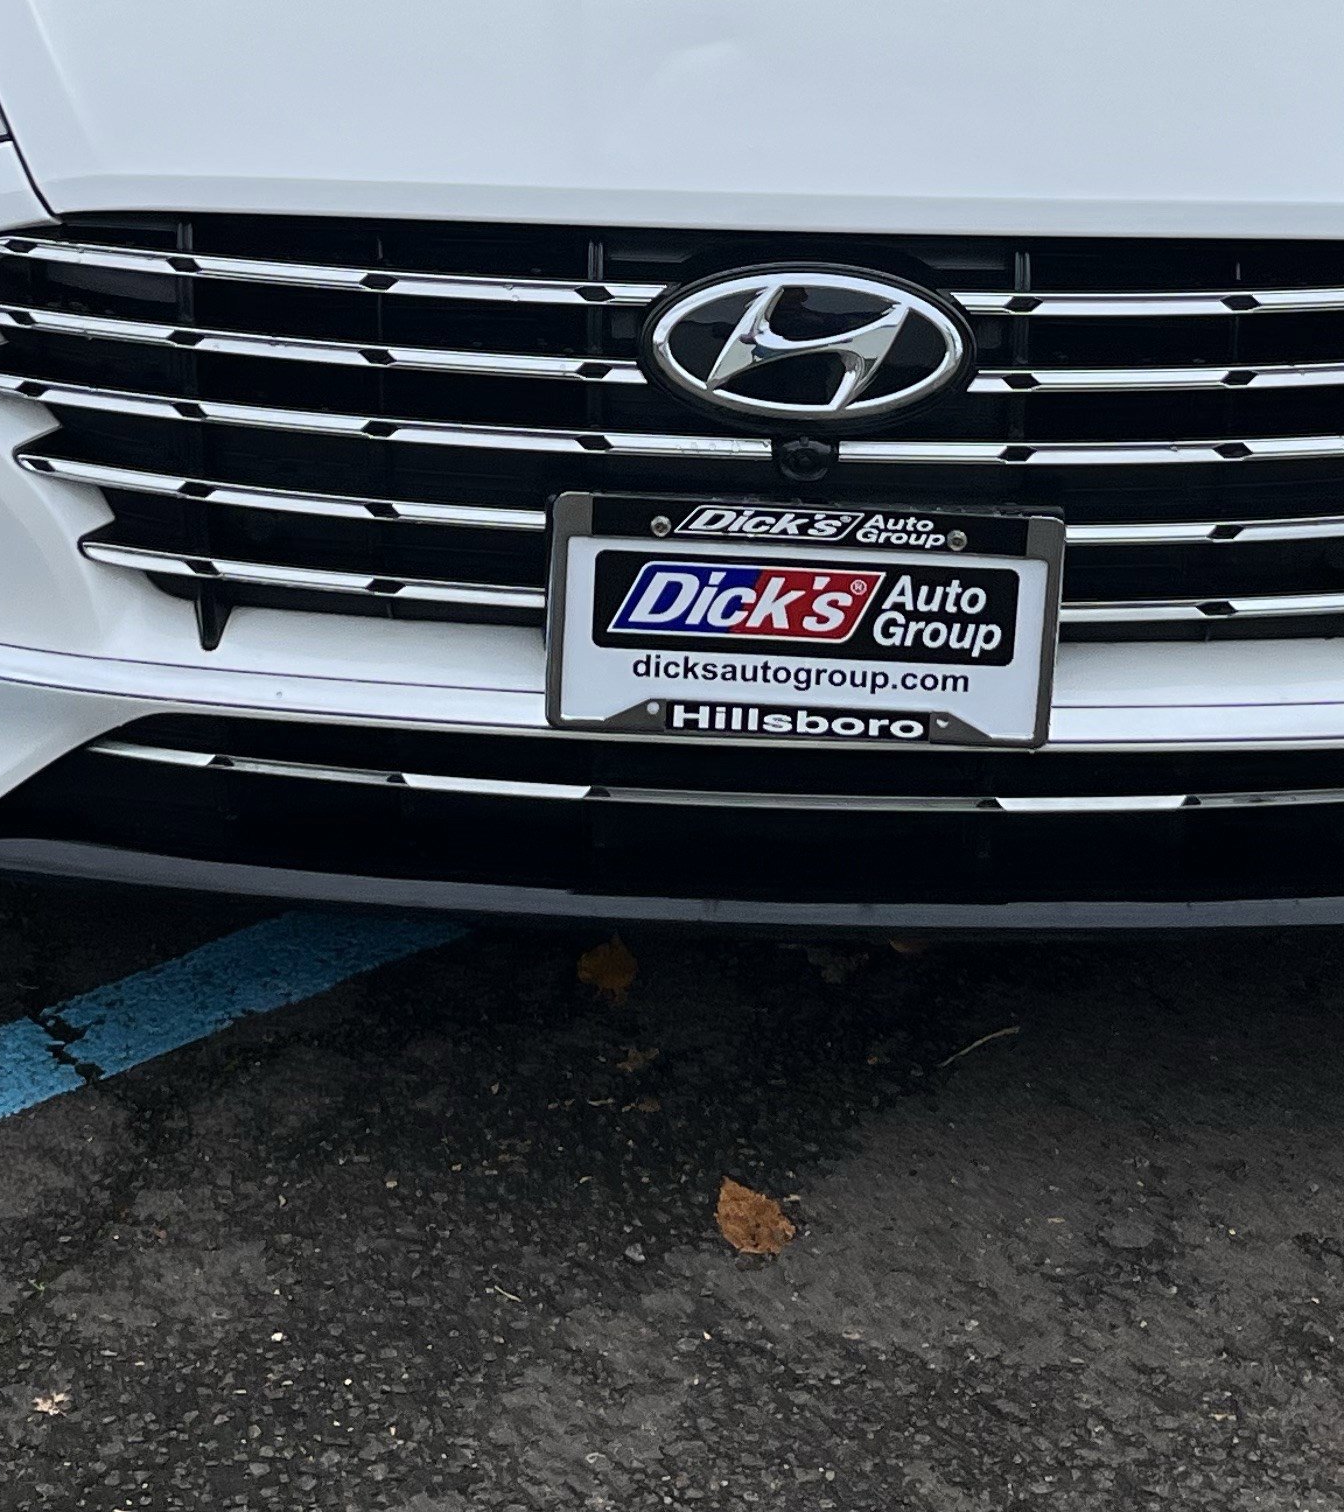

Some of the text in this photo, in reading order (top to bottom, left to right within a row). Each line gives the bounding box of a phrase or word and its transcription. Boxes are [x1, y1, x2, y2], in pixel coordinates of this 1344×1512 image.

[688, 509, 934, 537] Dick's Auto
[856, 528, 945, 549] Group
[627, 570, 987, 632] Dick's Auto
[872, 611, 1003, 658] Group
[632, 654, 970, 695] dicksautogroup.com
[671, 704, 925, 739] Hillsboro
